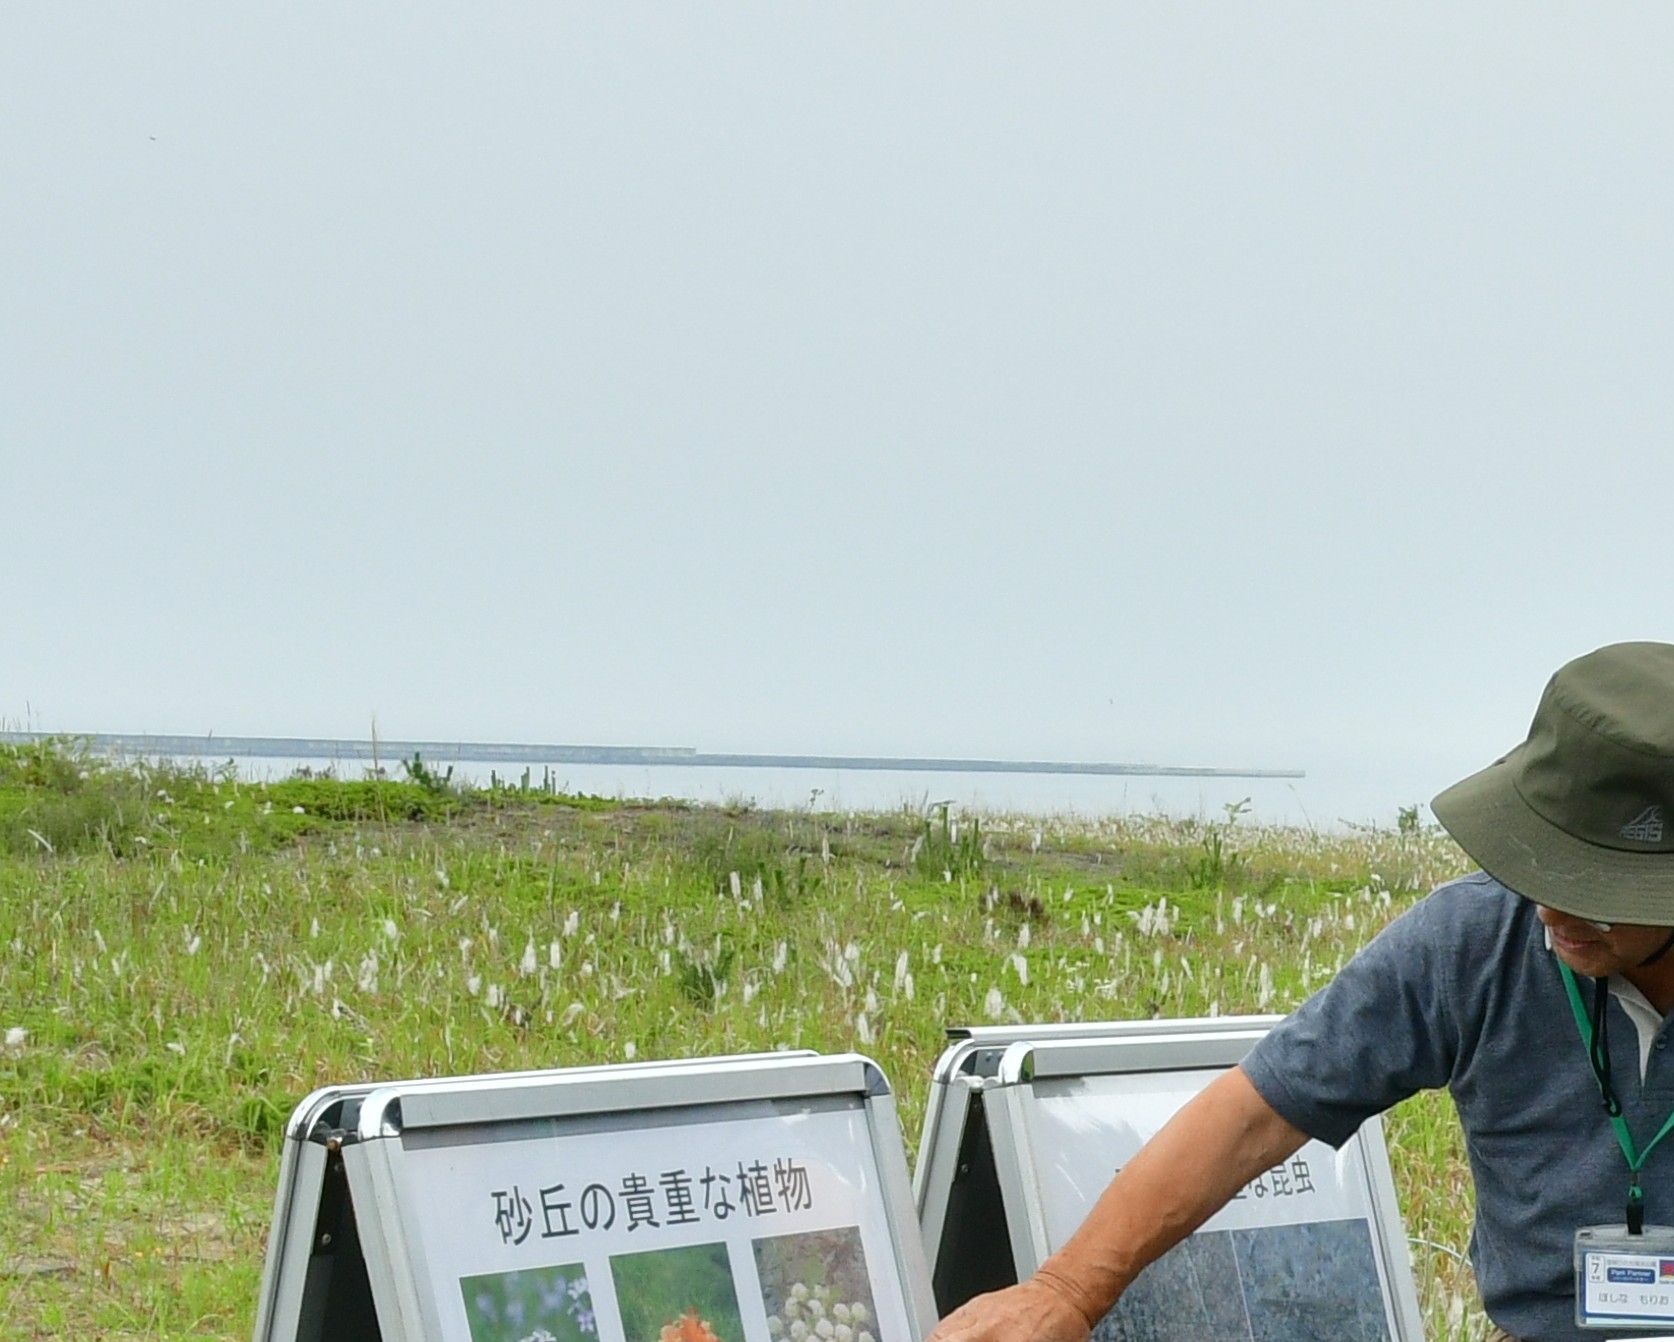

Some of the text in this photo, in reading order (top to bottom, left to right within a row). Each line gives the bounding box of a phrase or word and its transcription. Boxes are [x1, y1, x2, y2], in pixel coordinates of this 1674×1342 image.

[490, 1157, 813, 1246] 砂丘の貴重な植物
[1591, 1262, 1600, 1274] 7
